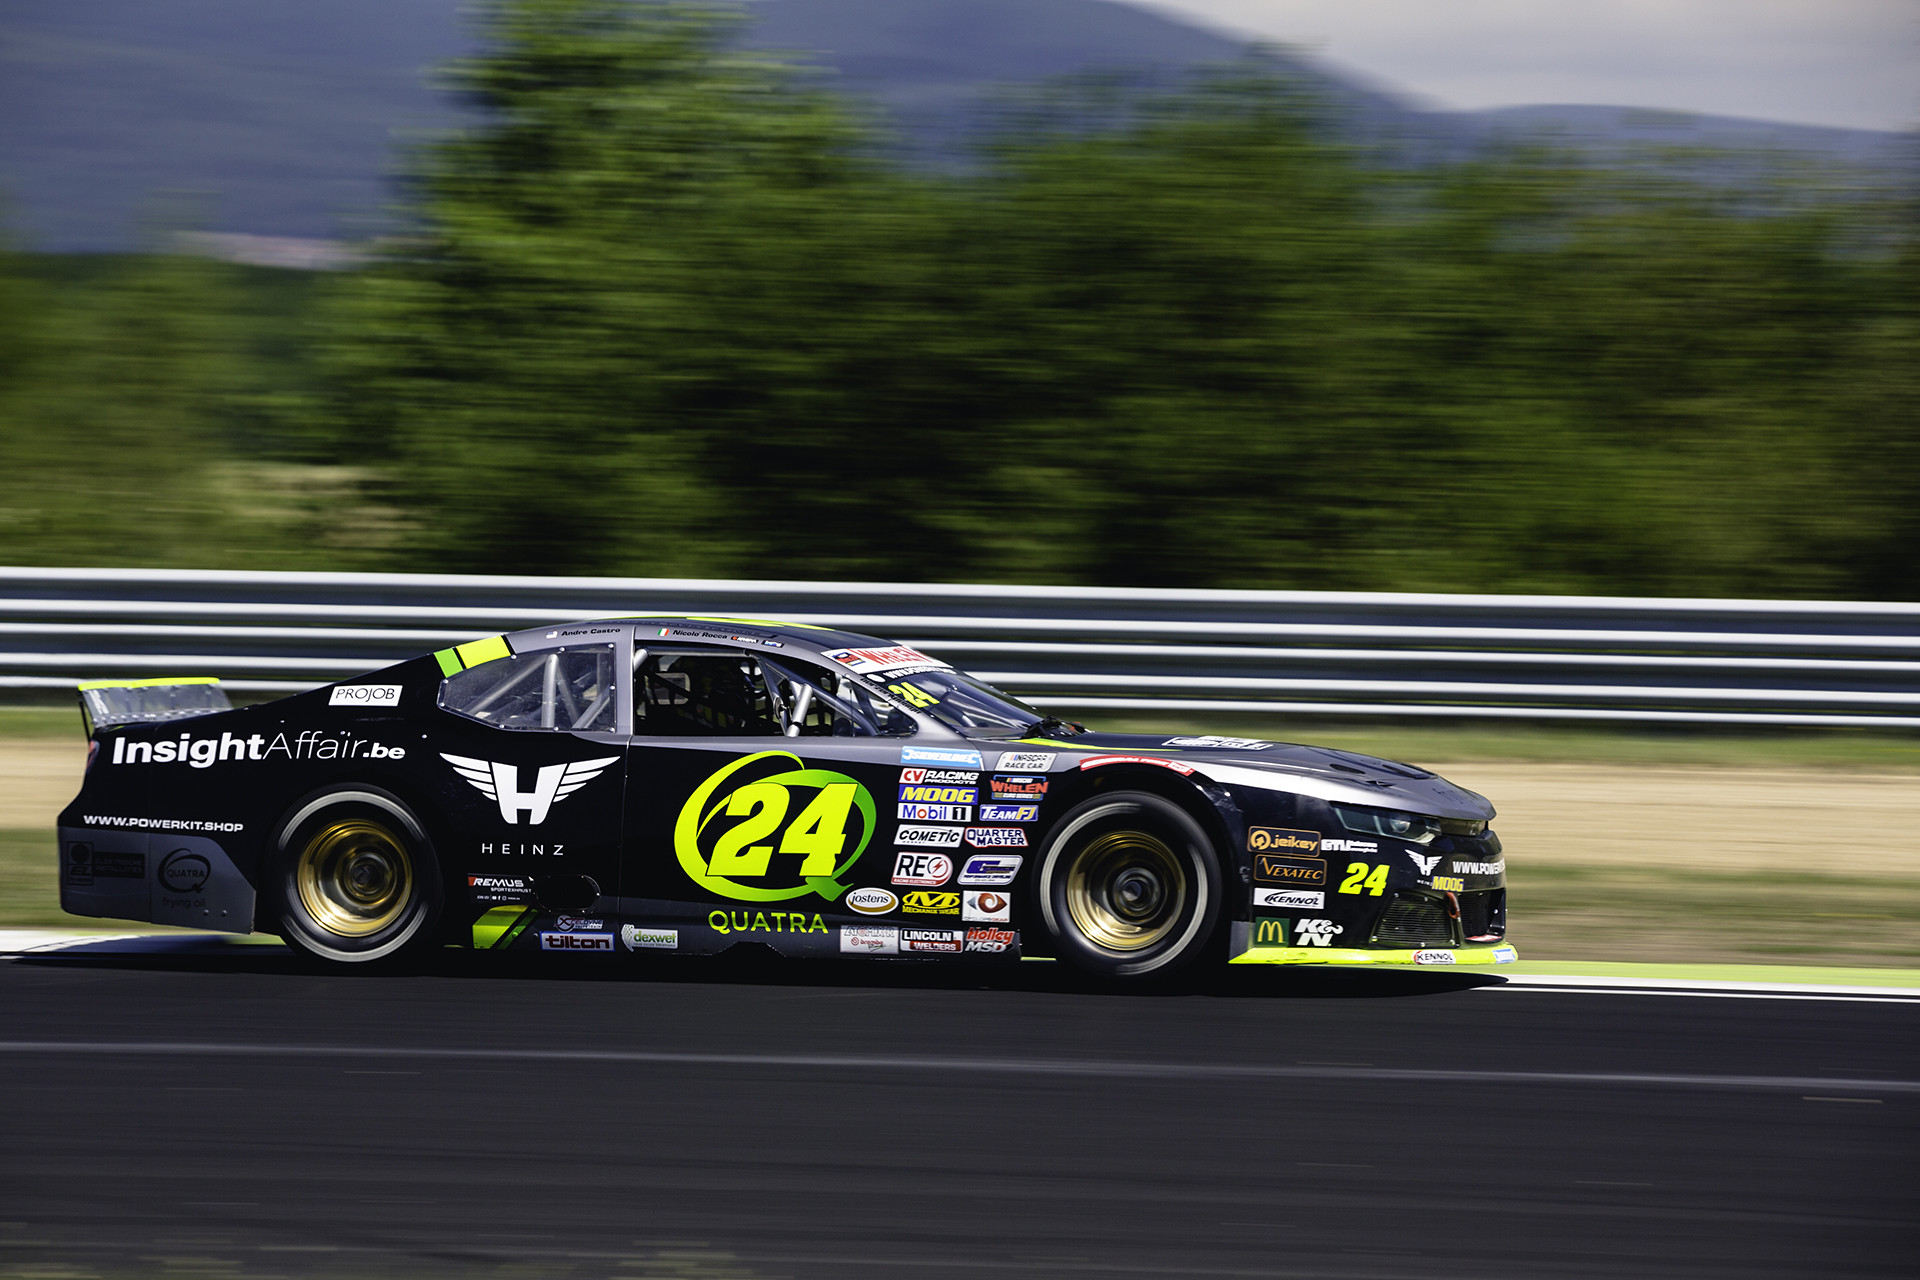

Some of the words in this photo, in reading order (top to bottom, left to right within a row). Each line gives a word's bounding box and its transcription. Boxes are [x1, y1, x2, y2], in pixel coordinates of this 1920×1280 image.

[335, 687, 396, 703] PROJOB
[887, 681, 941, 708] 24
[112, 730, 406, 769] InsightAffair.be
[904, 770, 924, 781] CV
[925, 770, 979, 781] RACING
[990, 780, 1049, 793] WHELEN
[901, 787, 976, 803] MOOG
[902, 804, 947, 819] Mobil
[83, 814, 244, 833] WWW.POWERKIT.SHOP
[706, 782, 858, 877] 24
[966, 828, 1023, 840] QUARTER
[976, 837, 1025, 846] MASTER
[1270, 834, 1318, 851] jeikey
[482, 842, 565, 857] HEINZ
[166, 869, 205, 878] QUATRA
[1259, 857, 1324, 880] VEXATEC
[473, 878, 524, 887] REMUS
[1337, 862, 1390, 897] 24
[1432, 876, 1464, 892] MOOG
[162, 896, 192, 908] frying
[193, 896, 206, 907] oil
[850, 892, 889, 906] jostens
[1267, 895, 1320, 906] KENNOL
[707, 909, 829, 935] QUATRA
[545, 935, 610, 949] tilton
[633, 930, 677, 944] dexwet
[904, 930, 952, 941] LINCOLN
[966, 926, 1015, 945] Holley
[913, 942, 956, 951] WELDERS
[965, 941, 1007, 952] MSD
[1416, 952, 1453, 962] KENNOL
